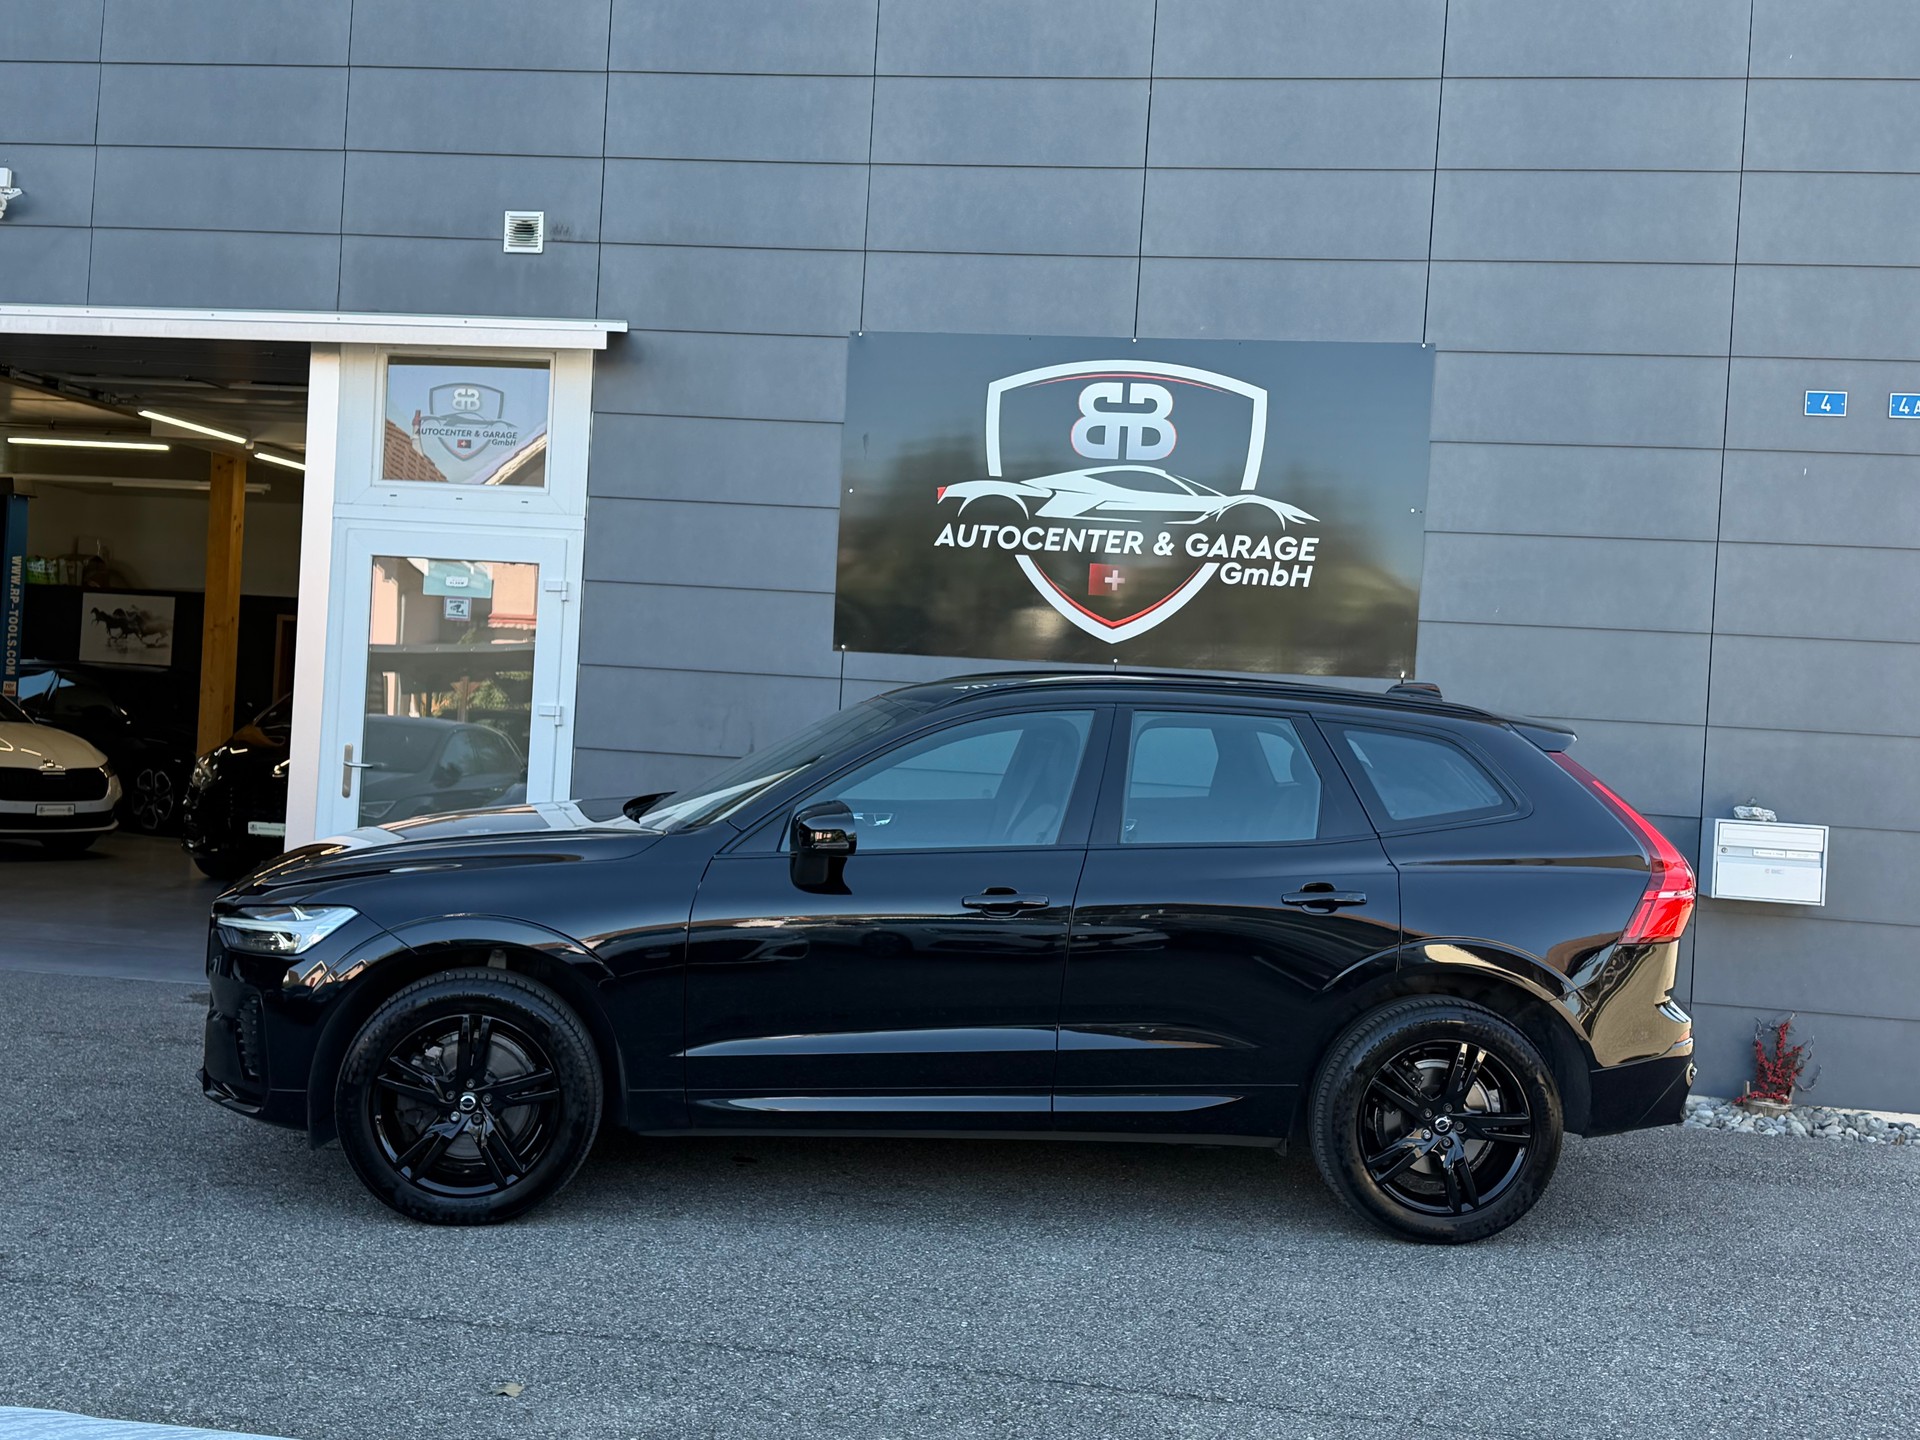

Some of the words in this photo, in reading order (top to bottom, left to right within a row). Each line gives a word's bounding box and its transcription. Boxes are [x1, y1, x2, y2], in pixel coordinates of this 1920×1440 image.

[1820, 394, 1831, 412] 4
[415, 428, 472, 437] AUTOCENTER
[482, 431, 518, 439] GARAGE
[933, 522, 1143, 556] AUTOCENTER
[1152, 533, 1176, 557] &
[1185, 534, 1320, 563] GARAGE
[1219, 562, 1314, 589] GmbH
[5, 555, 22, 675] WWW.RP-TOOLS.COM
